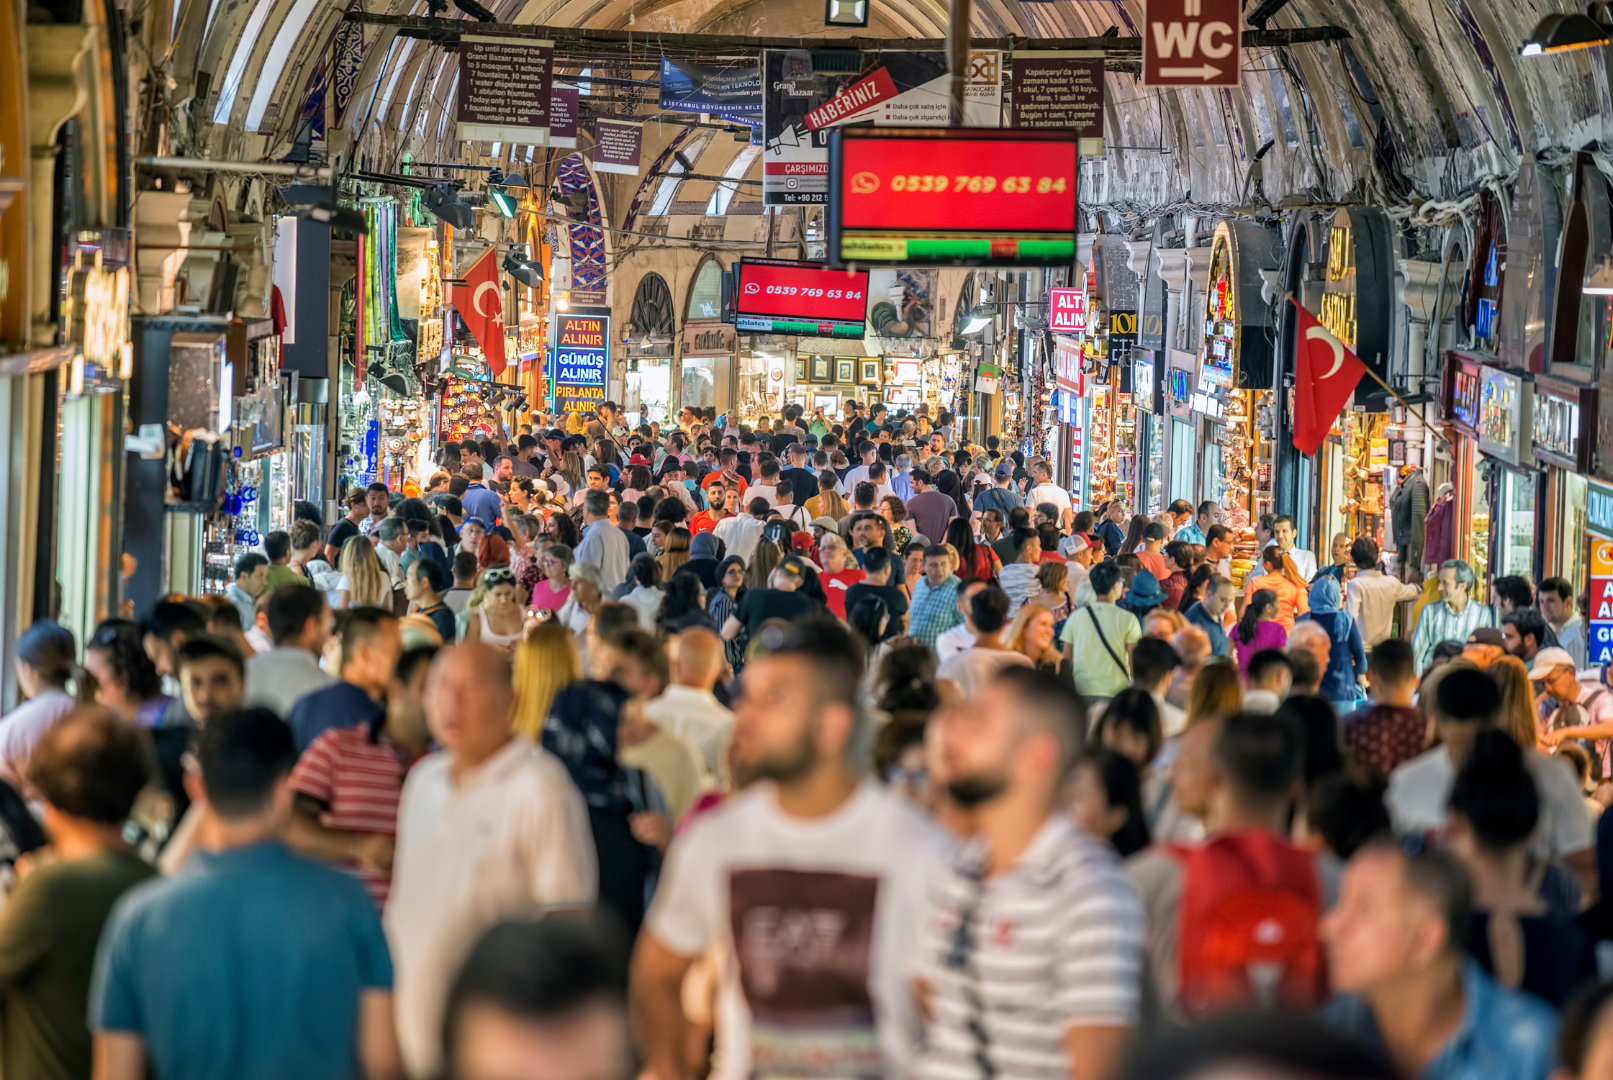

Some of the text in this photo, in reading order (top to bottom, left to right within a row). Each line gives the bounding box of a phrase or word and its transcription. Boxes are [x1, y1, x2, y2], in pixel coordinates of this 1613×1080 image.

[1152, 21, 1233, 59] WC
[474, 44, 484, 52] Up
[501, 47, 528, 55] recently
[489, 54, 512, 62] Bazaar
[528, 57, 546, 65] home
[481, 63, 514, 71] mosques,
[521, 65, 545, 73] school,
[1025, 69, 1072, 77] Kapalıçarşı'da
[477, 70, 510, 80] fountains,
[521, 74, 540, 82] wells,
[495, 80, 527, 89] dispenser
[732, 80, 760, 89] TEKNOLO
[773, 82, 796, 92] Grand
[479, 88, 506, 96] ablution
[507, 90, 536, 98] fountain.
[469, 96, 489, 105] Today
[669, 101, 699, 109] İSTANBUL
[809, 81, 880, 128] HABERİNİZ
[469, 104, 496, 112] fountain
[1020, 112, 1042, 120] Bugün
[1049, 111, 1067, 119] cami,
[785, 165, 828, 174] ÇARŞIMIZD
[890, 175, 1067, 194] 0539 769 63 84
[766, 286, 861, 300] 0539 769 63 84
[1058, 295, 1082, 309] ALT
[1054, 312, 1084, 326] ALIN
[1110, 313, 1138, 334] 101
[565, 320, 600, 331] ALTIN
[562, 334, 602, 346] ALINIR
[559, 352, 604, 368] GÜMÜŞ
[561, 368, 601, 380] ALINIR
[556, 386, 604, 399] PIRLANTA
[563, 401, 596, 412] ALINIR
